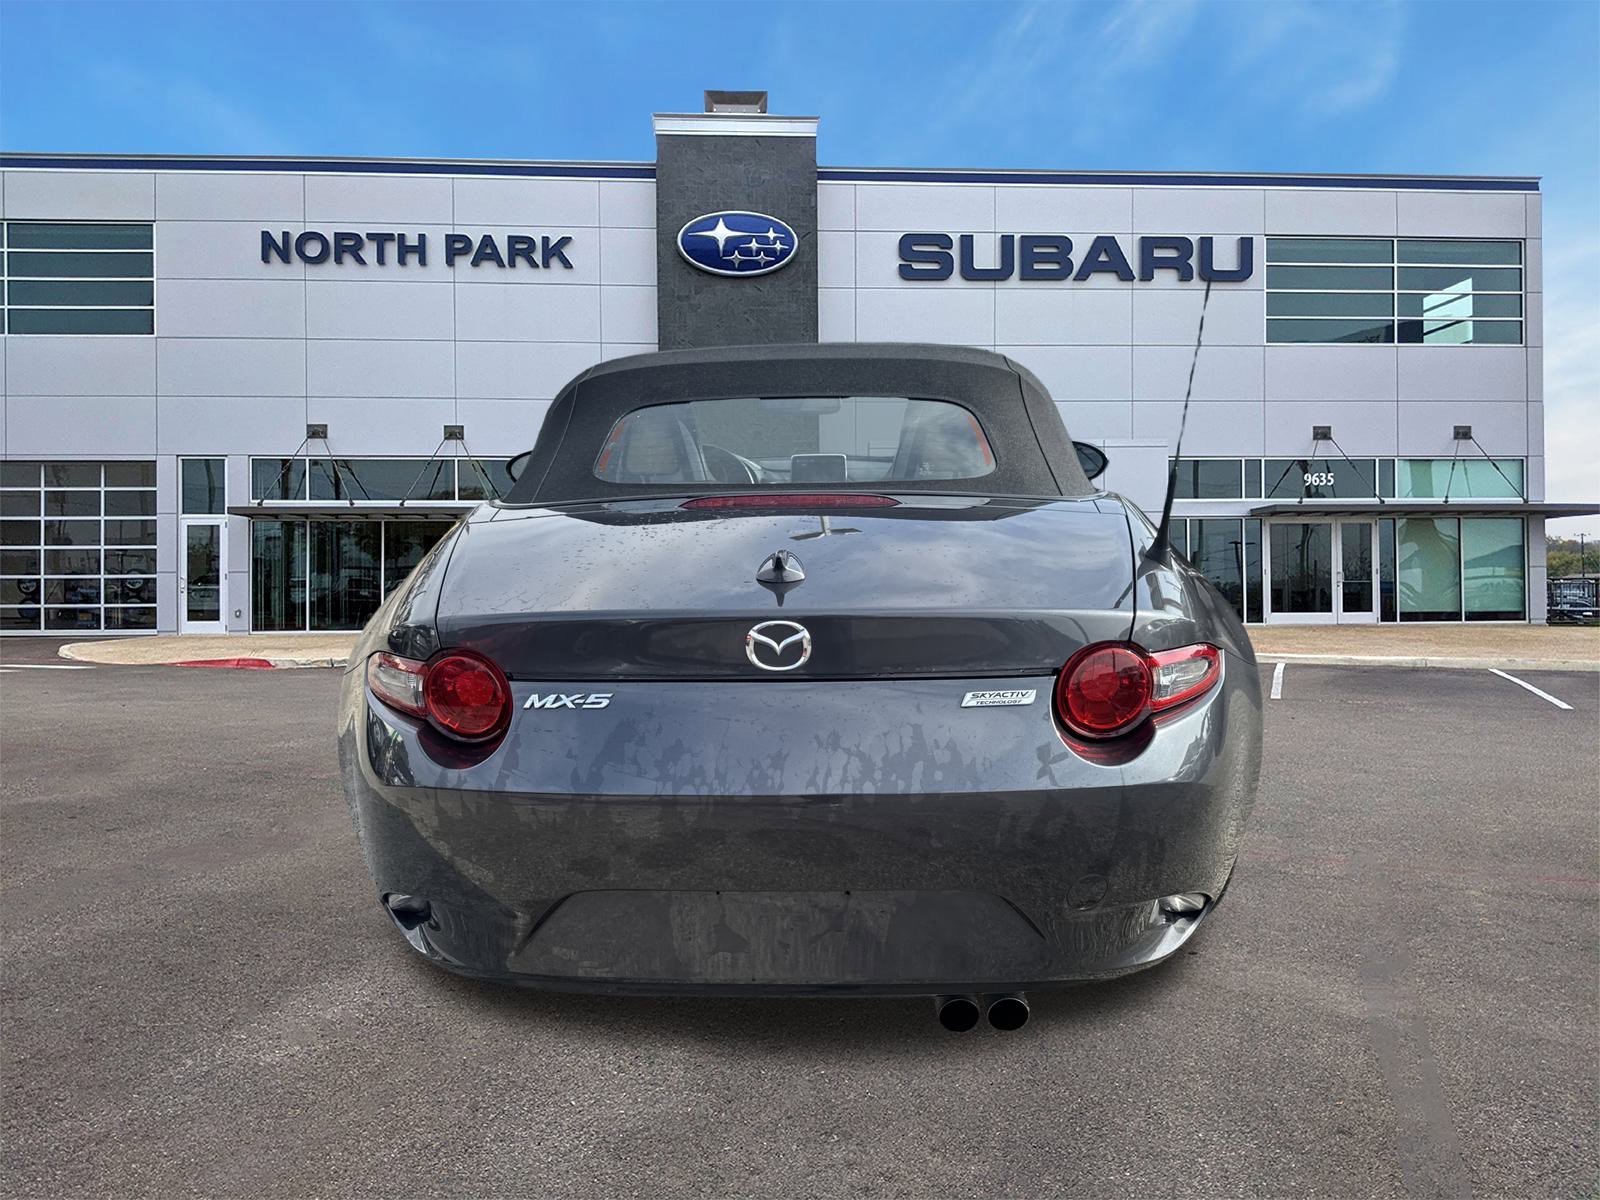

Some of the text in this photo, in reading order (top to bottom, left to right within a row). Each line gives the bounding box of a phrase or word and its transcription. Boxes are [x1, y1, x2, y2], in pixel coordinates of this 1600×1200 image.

[261, 230, 574, 269] NORTH PARK
[898, 232, 1254, 283] SUBARU
[1303, 472, 1335, 487] 9635
[523, 693, 614, 709] MX-5
[971, 691, 1029, 699] SKYACTIV
